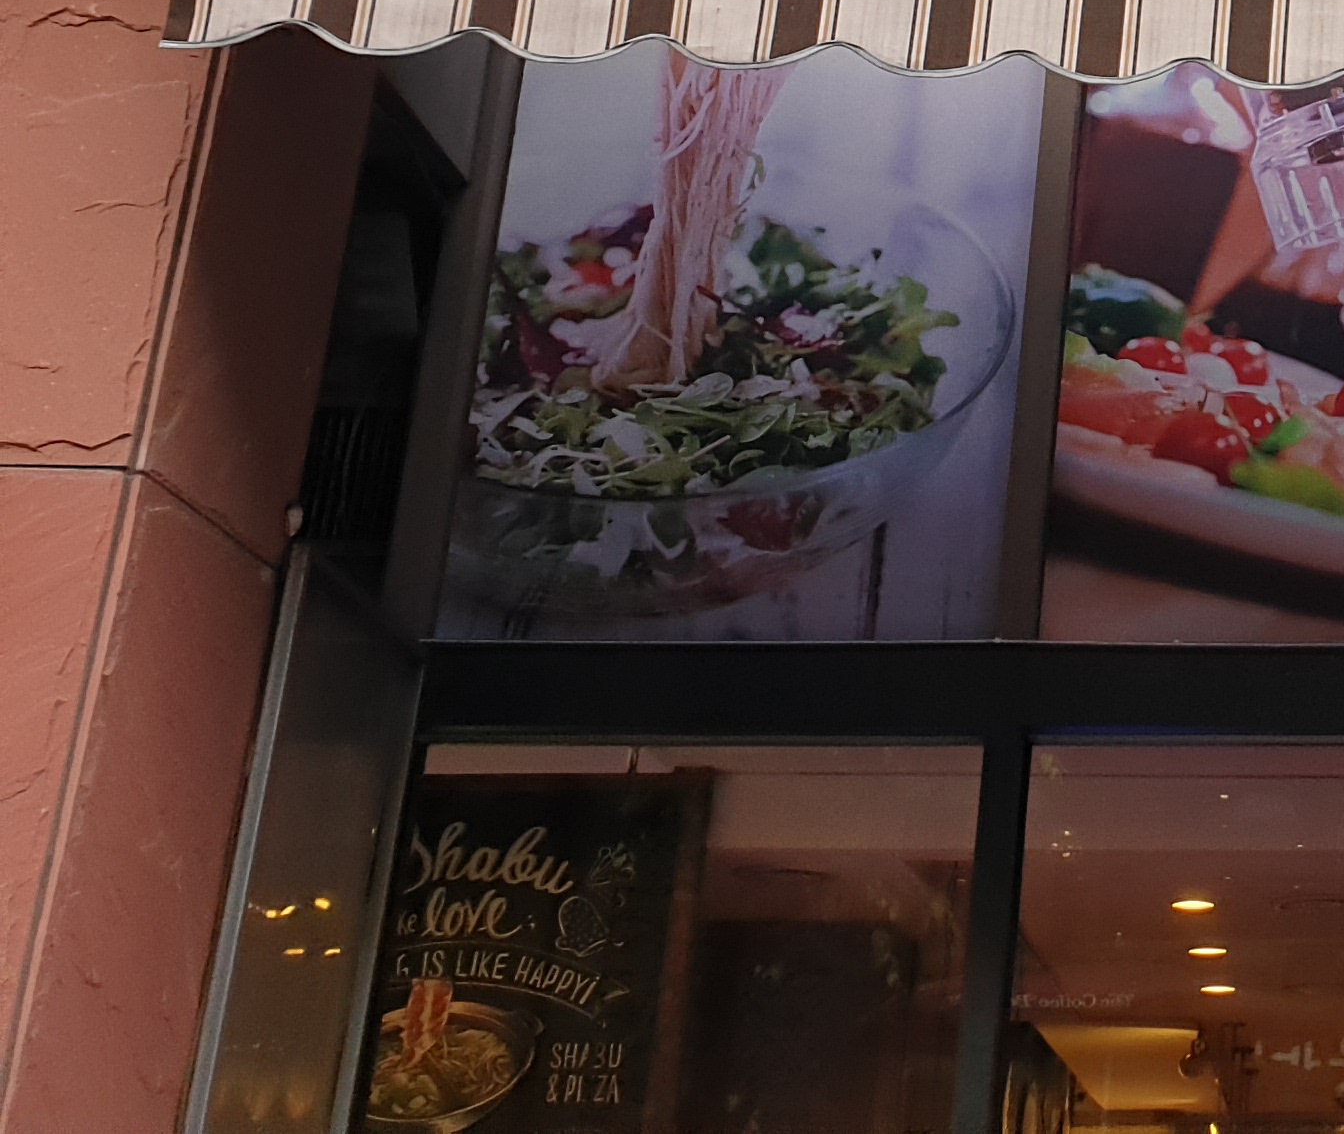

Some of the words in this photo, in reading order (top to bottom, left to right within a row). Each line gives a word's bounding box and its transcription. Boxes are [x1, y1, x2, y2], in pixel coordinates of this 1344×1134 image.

[421, 886, 523, 939] love
[422, 949, 445, 977] IS
[455, 949, 509, 980] LIKE
